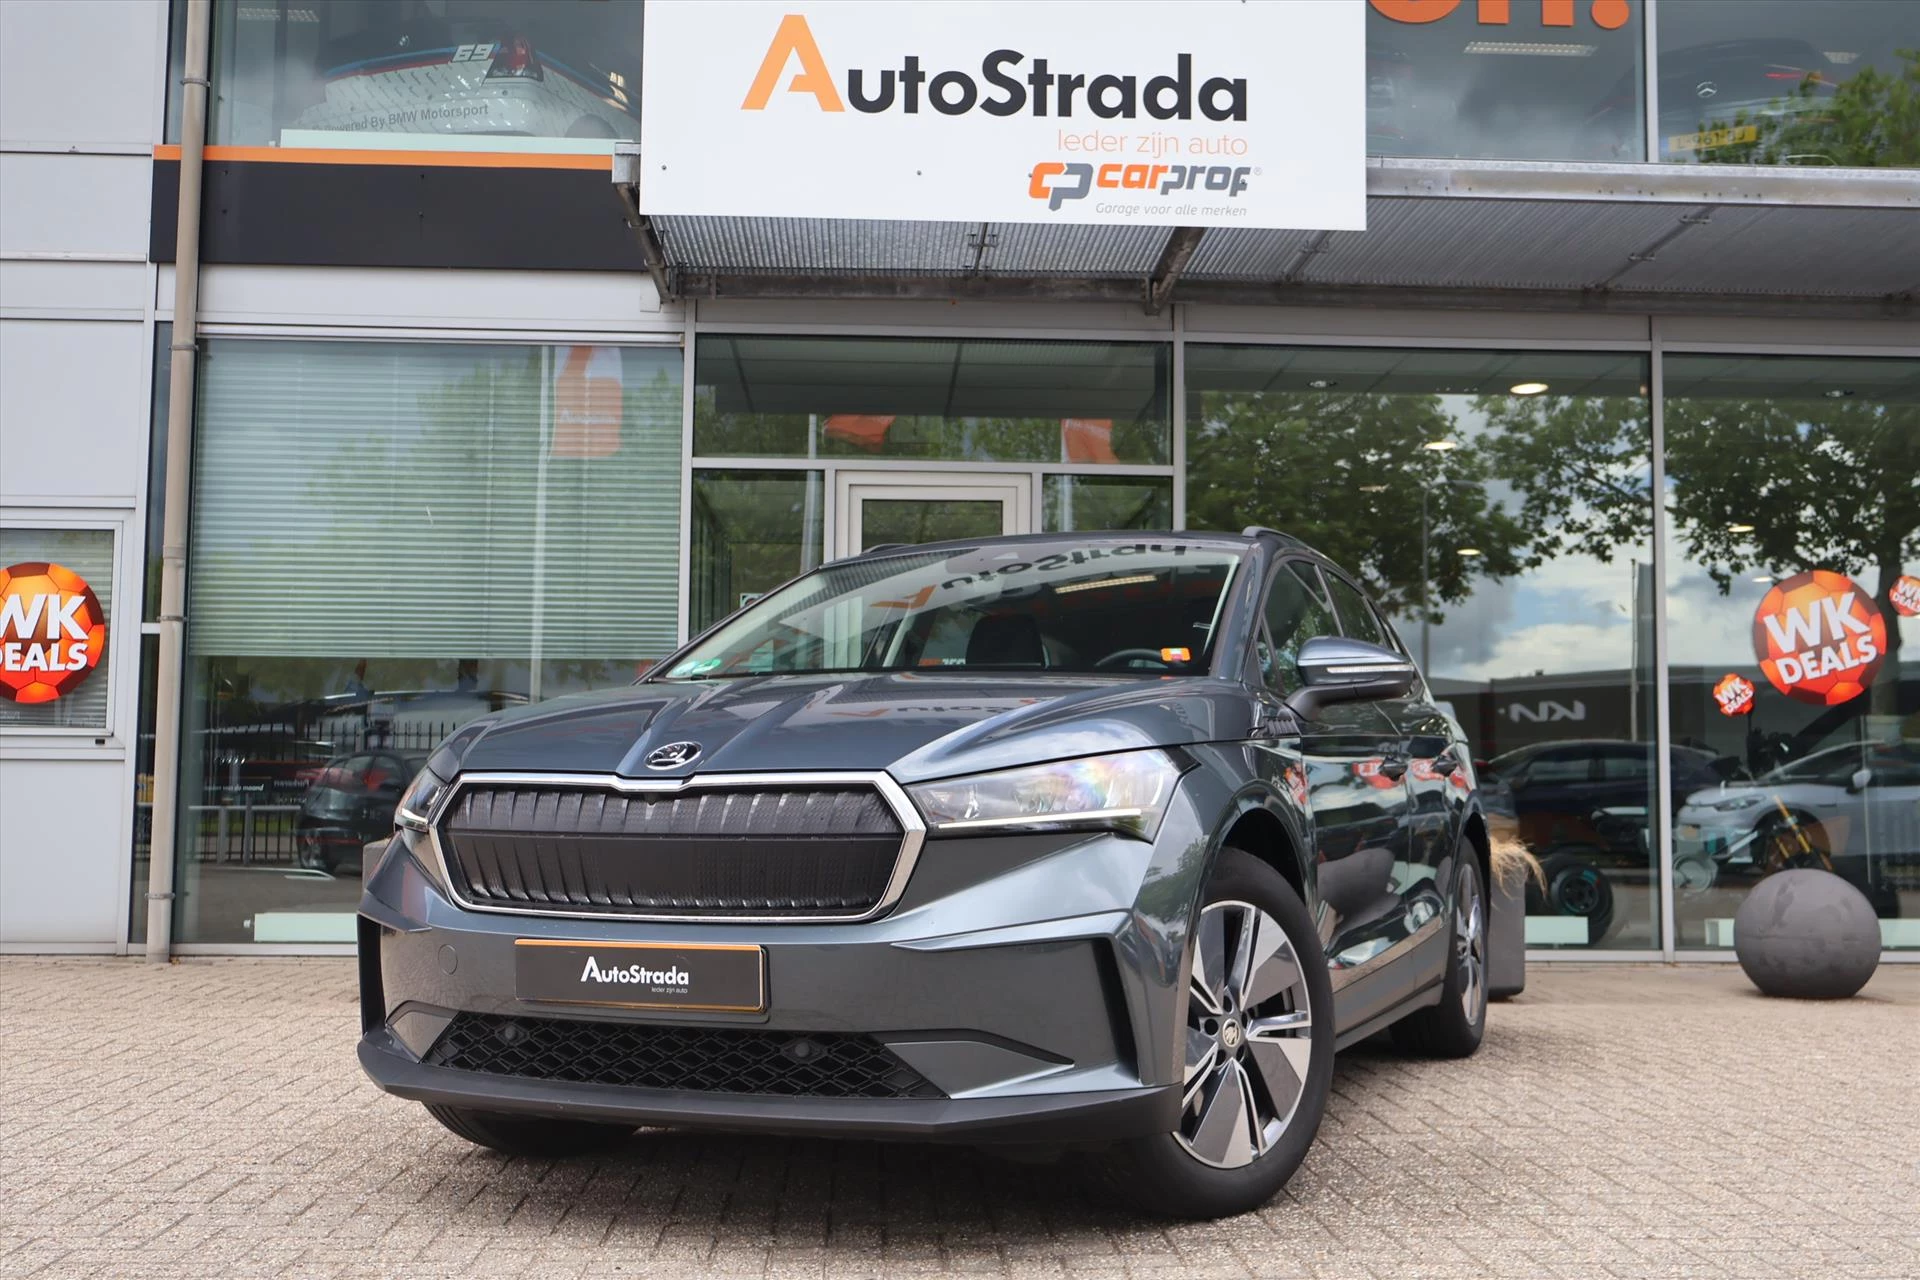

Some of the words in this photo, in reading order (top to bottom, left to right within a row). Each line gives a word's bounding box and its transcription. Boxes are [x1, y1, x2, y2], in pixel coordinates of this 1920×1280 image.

[451, 43, 496, 63] 69
[740, 14, 1249, 122] AutoStrada
[371, 115, 385, 129] By
[388, 109, 418, 125] BMW
[420, 104, 489, 121] Motorsport
[1058, 129, 1128, 153] Ieder
[1136, 132, 1179, 159] zijn
[1188, 136, 1248, 156] auto
[1096, 163, 1251, 197] carprof
[1095, 202, 1140, 216] Garage
[1144, 204, 1171, 216] voor
[1174, 203, 1198, 216] alle
[1201, 205, 1247, 217] merken
[0, 593, 89, 640] WK
[1763, 591, 1871, 654] WK
[0, 641, 88, 672] EALS
[1775, 634, 1878, 685] DEALS
[1715, 677, 1747, 705] WK
[1725, 687, 1754, 714] DEALS
[580, 956, 689, 985] AutoStrada
